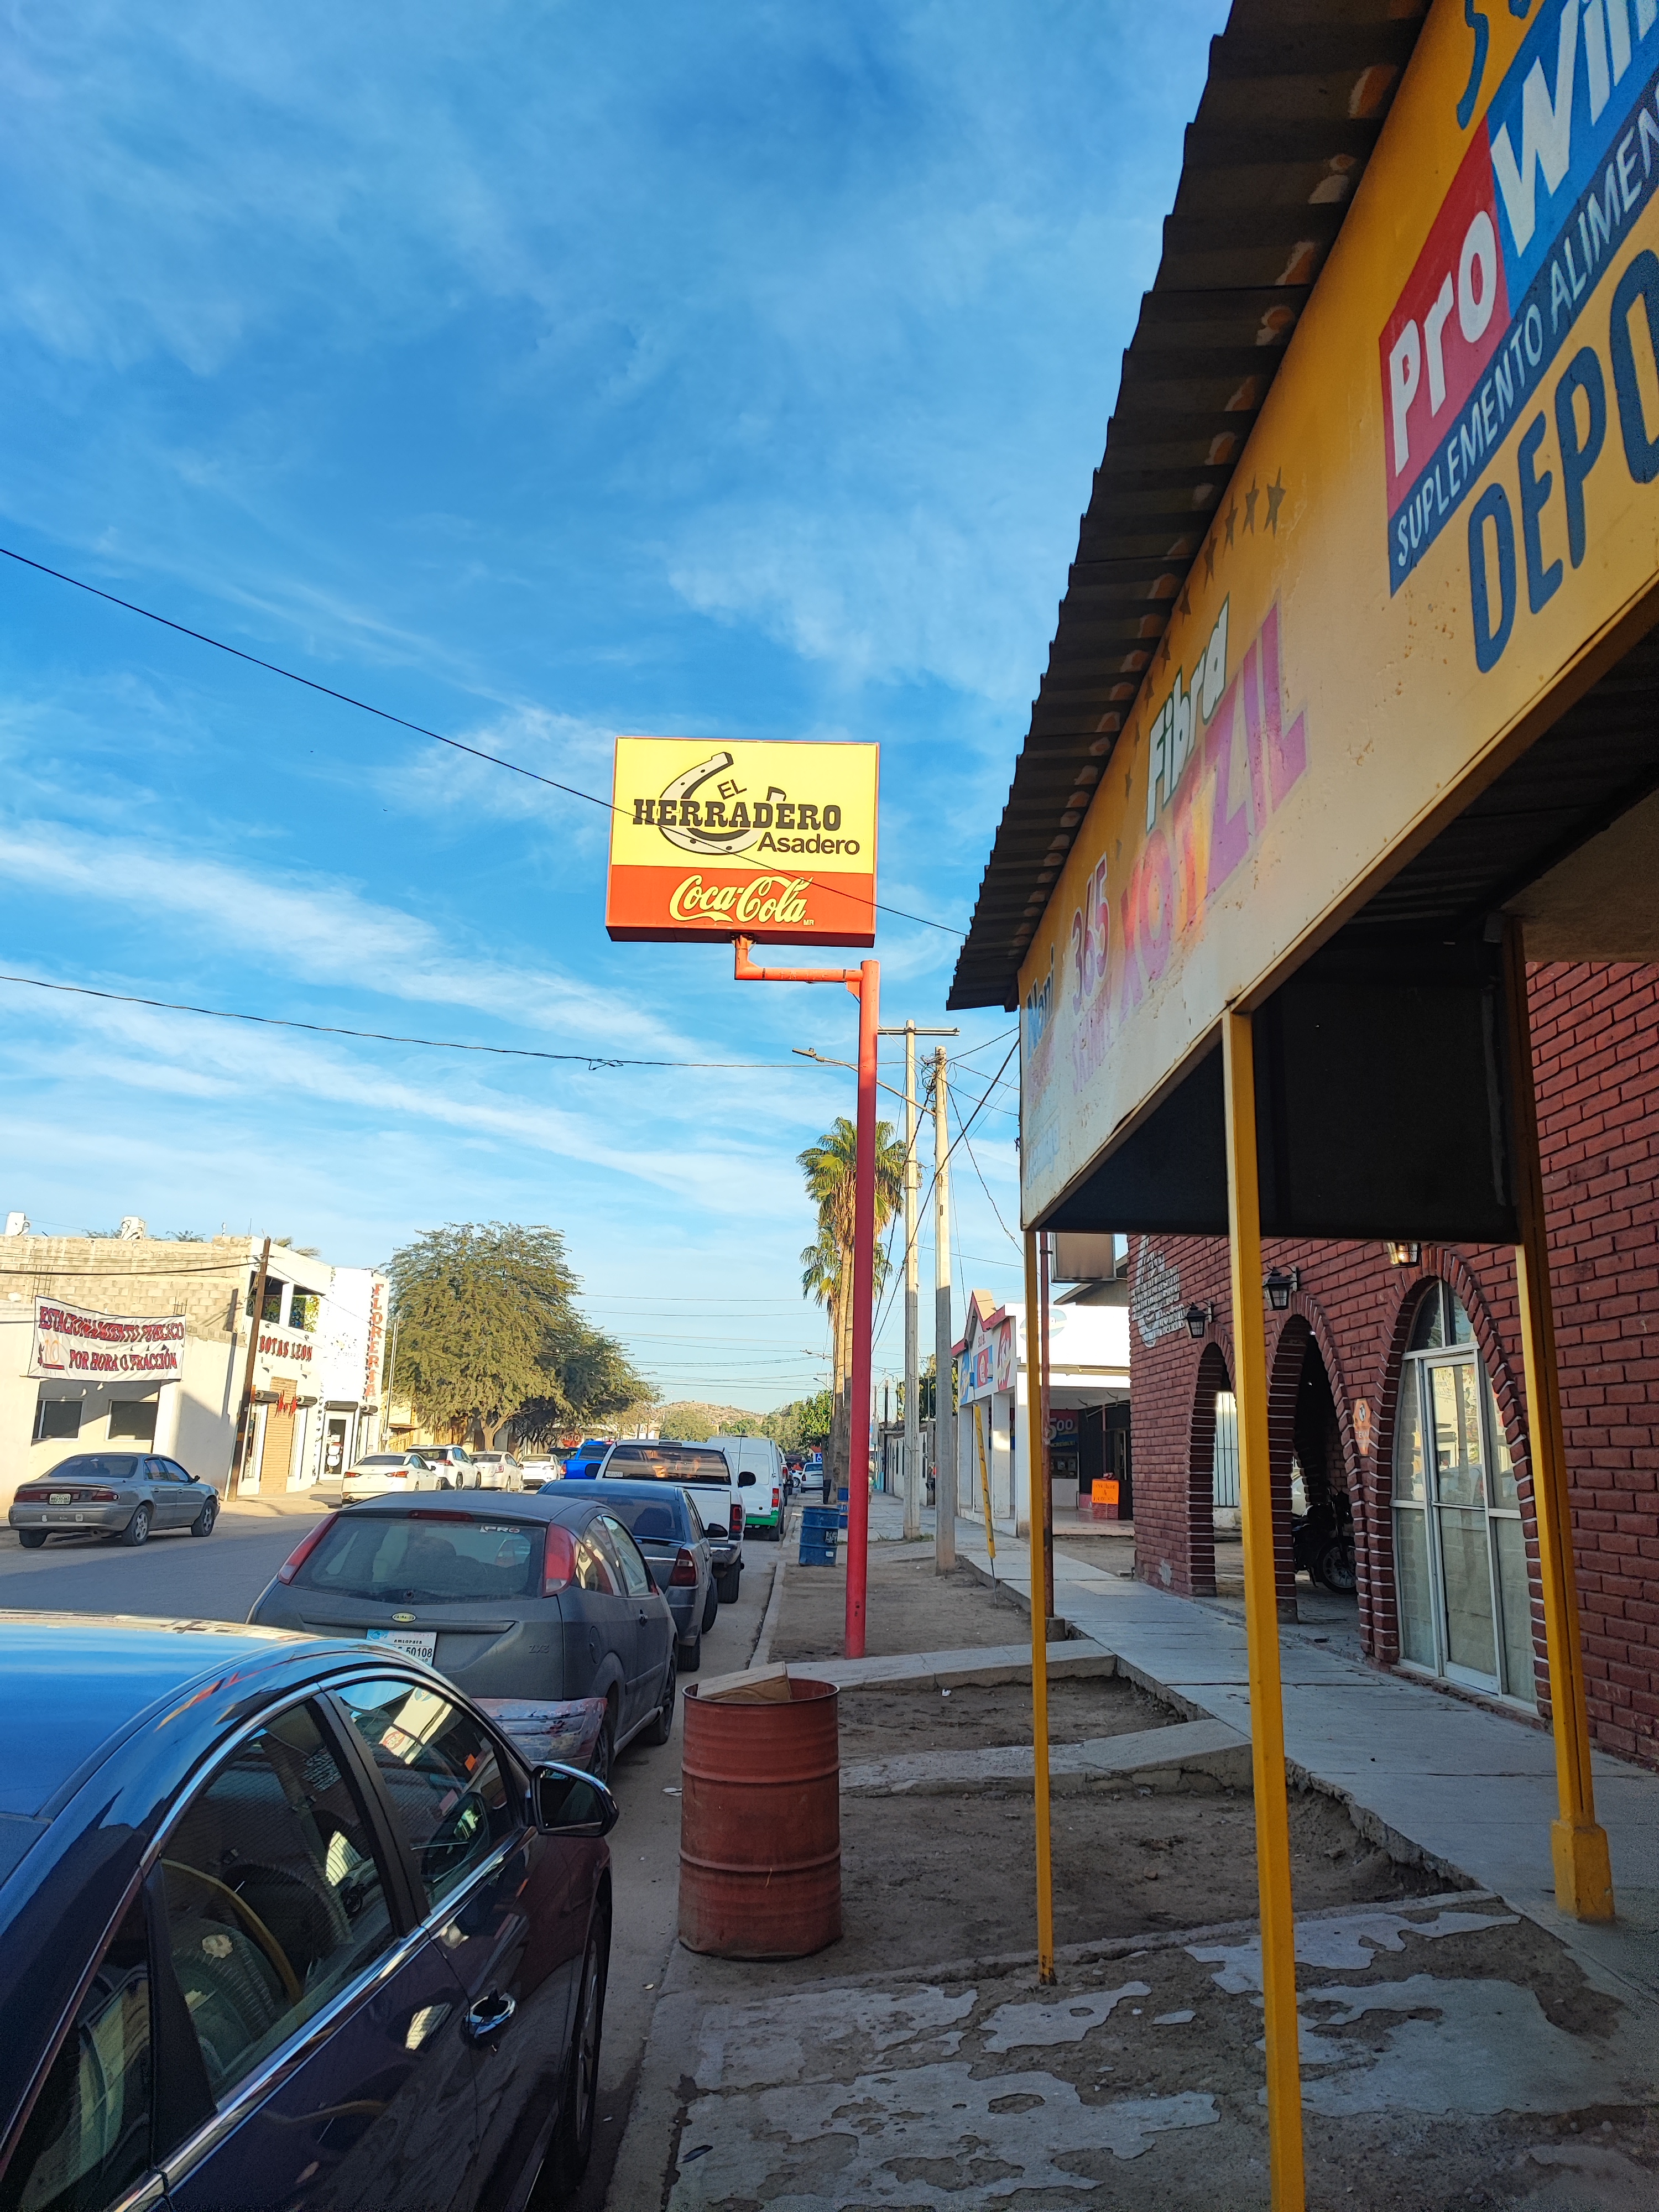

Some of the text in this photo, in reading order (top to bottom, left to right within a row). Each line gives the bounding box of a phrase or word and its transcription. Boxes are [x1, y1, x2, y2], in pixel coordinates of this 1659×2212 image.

[1398, 304, 1543, 567] SUPLEMENTO
[1145, 591, 1230, 836] Fibra
[717, 779, 747, 800] EL
[633, 799, 841, 831] HERRADERO
[1119, 600, 1307, 1025] XOTZIL
[757, 832, 860, 855] Asadero
[669, 874, 814, 924] Coca-Cola
[1072, 852, 1109, 1016] 365
[69, 1349, 89, 1370] POR
[90, 1352, 119, 1371] HORA
[120, 1354, 128, 1371] O
[258, 1334, 313, 1362] BOTAS LEON
[365, 1283, 384, 1397] FLORERIA
[529, 1645, 550, 1654] ZX3
